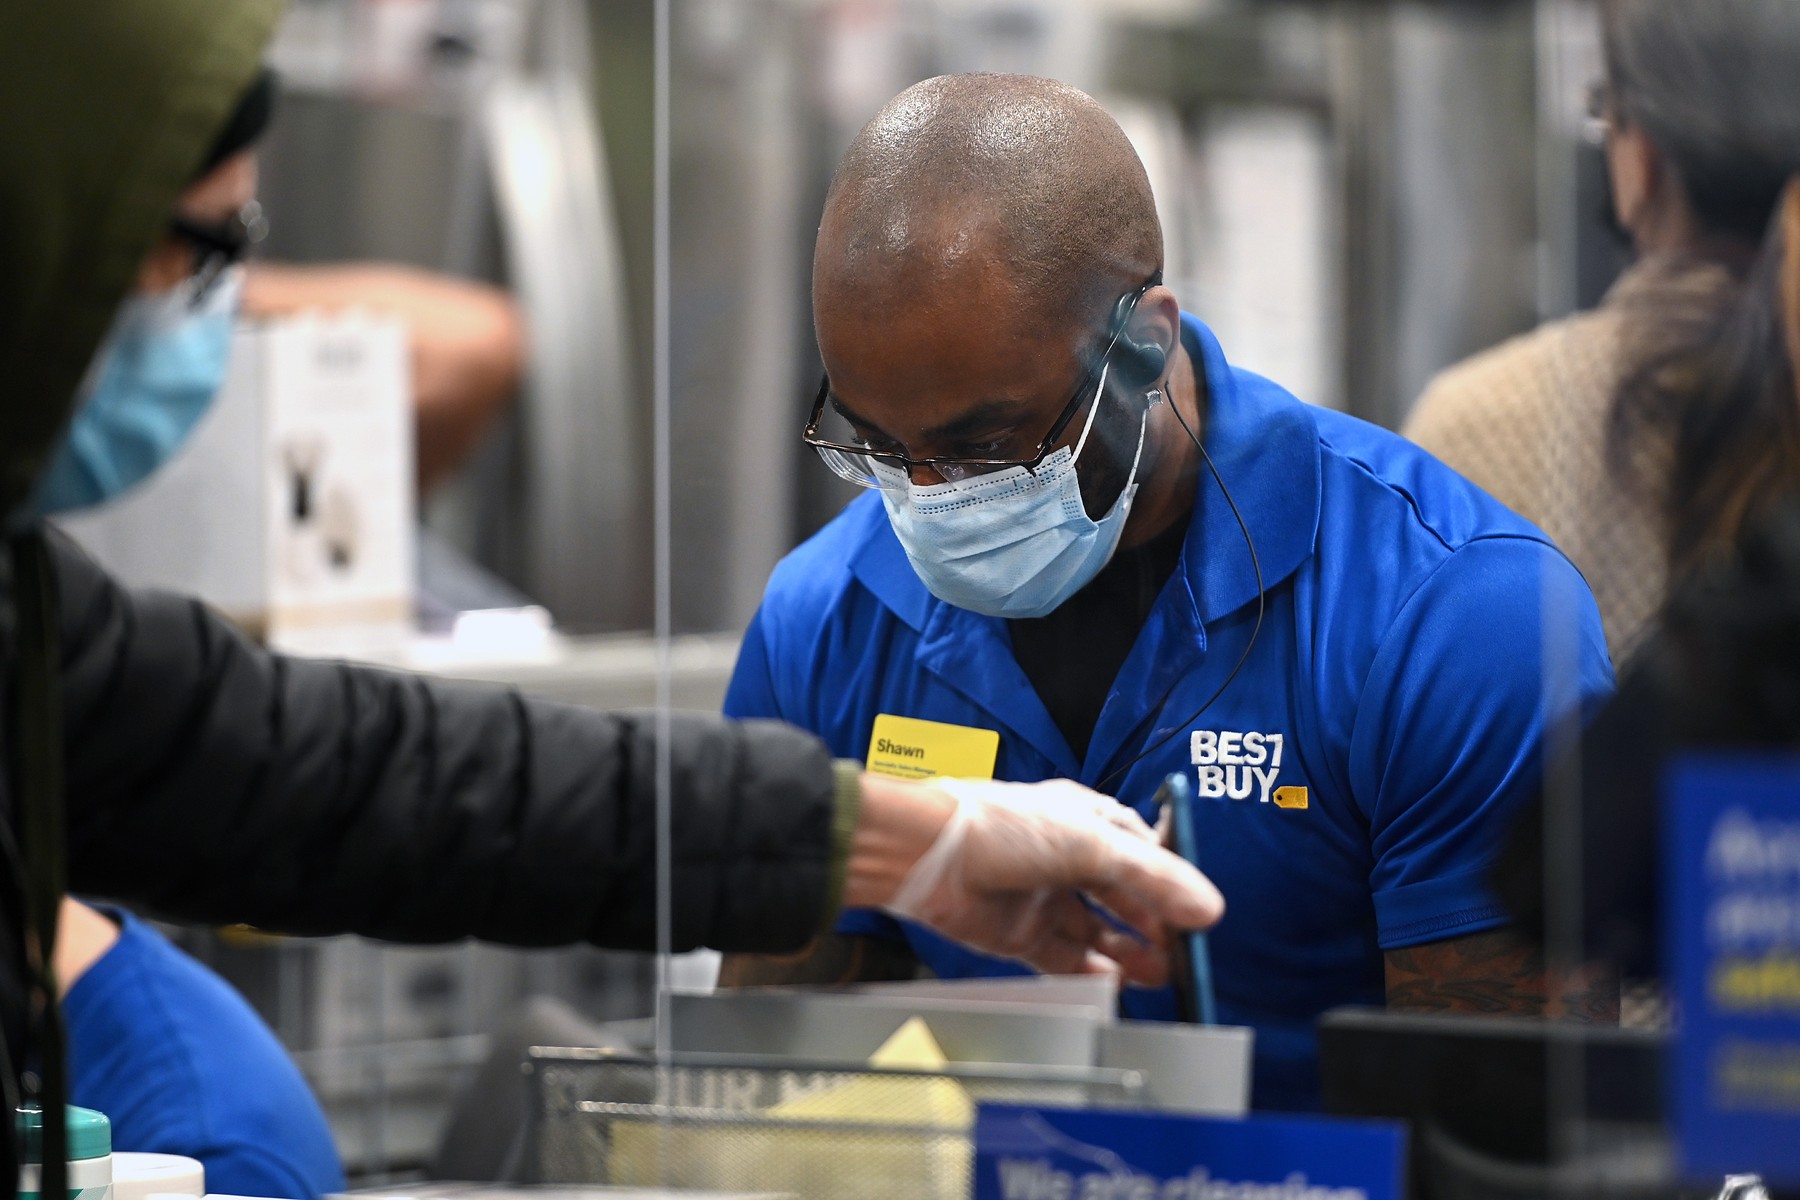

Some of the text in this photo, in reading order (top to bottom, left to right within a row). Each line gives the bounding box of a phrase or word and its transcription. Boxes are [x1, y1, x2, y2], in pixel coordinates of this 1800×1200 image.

[876, 738, 925, 759] Shawn
[1190, 730, 1283, 767] BEST
[1198, 765, 1280, 802] BUY
[999, 1157, 1072, 1200] We
[1078, 1171, 1158, 1200] are
